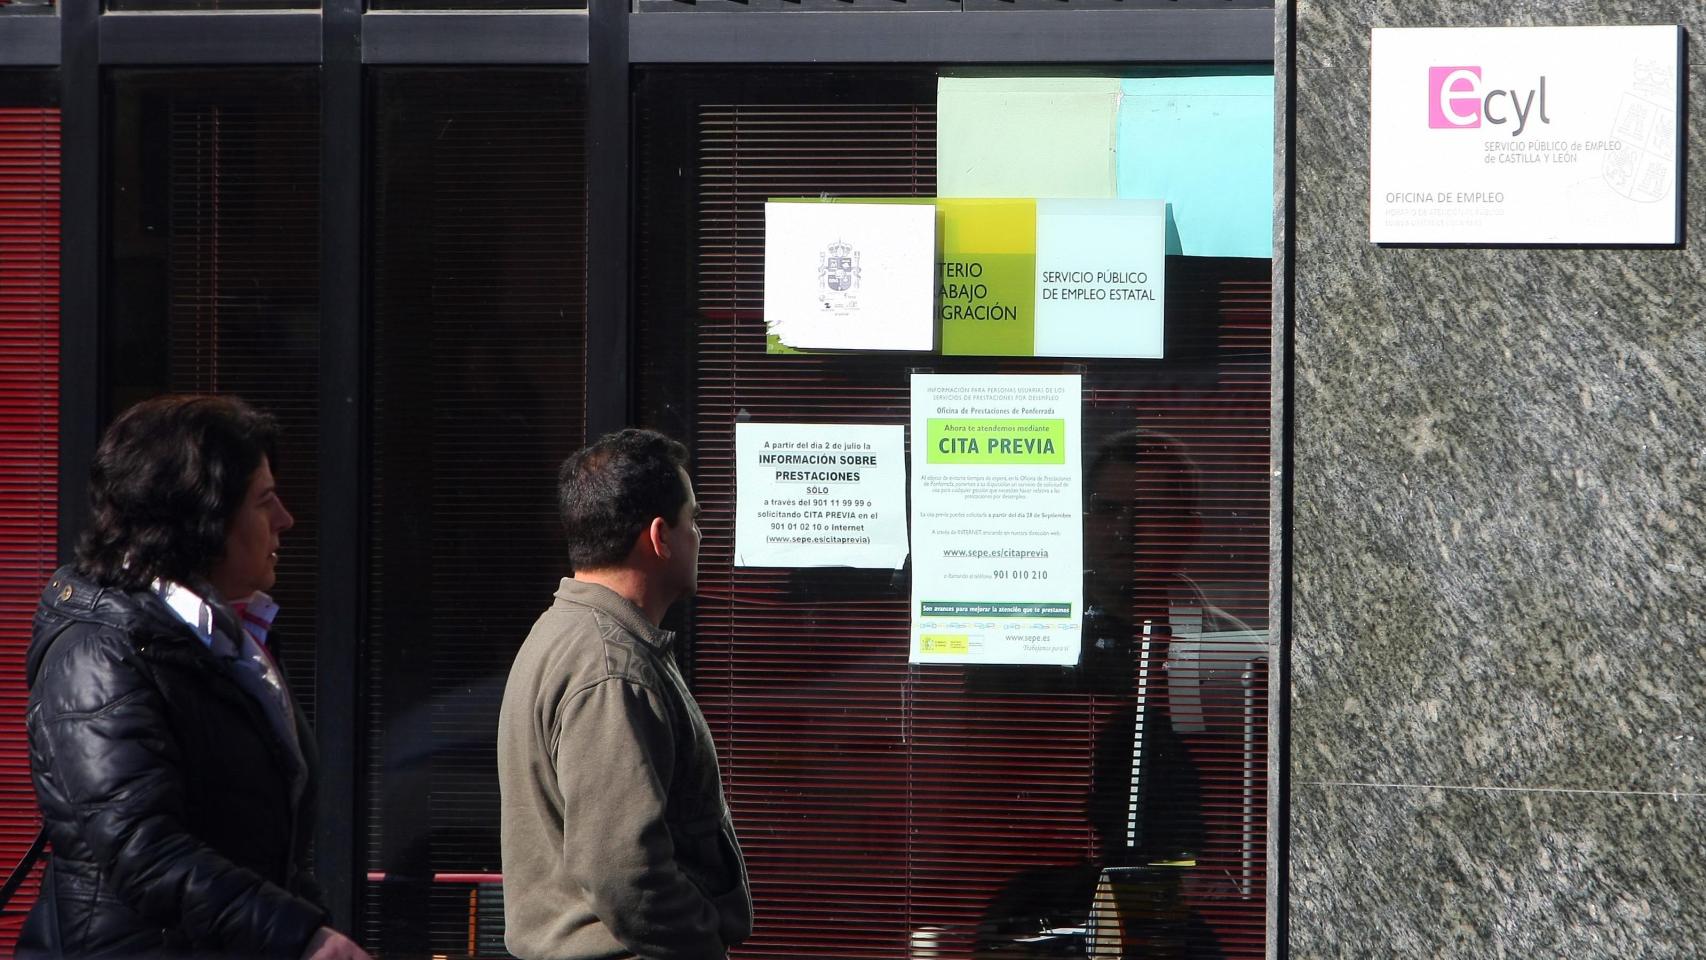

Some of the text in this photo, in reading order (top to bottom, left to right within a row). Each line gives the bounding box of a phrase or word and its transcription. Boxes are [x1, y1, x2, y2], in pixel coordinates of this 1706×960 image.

[1440, 68, 1550, 137] ecyl
[1484, 139, 1622, 152] SERVICIO PÚBLICO de EMPLEO
[1484, 151, 1577, 164] de CASTILLA Y LEÓN
[1386, 192, 1504, 203] OFICINA DE EMPLEO
[1042, 268, 1148, 284] SERVICIO PÚBLICO
[936, 284, 987, 303] ABAJO
[1042, 288, 1156, 300] DE EMPLEO ESTATAL
[934, 302, 1017, 320] IGRACIÓN
[936, 407, 1055, 415] Oficina de Prestaciones de Ponferrada
[772, 441, 794, 450] partir
[844, 442, 861, 451] julio
[939, 437, 1055, 454] CITA PREVIA
[759, 452, 877, 465] INFORMACIÓN SOBRE
[775, 471, 860, 482] PRESTACIONES
[812, 499, 827, 507] 901
[830, 499, 839, 507] 11
[842, 499, 852, 507] 99
[854, 499, 864, 507] 99
[770, 523, 785, 531] 901
[787, 523, 796, 531] 01
[799, 523, 810, 531] 02
[812, 523, 822, 531] 10
[943, 548, 1048, 559] www.sepe.es/citaprevia
[993, 570, 1008, 580] 901
[1012, 570, 1029, 580] 010
[1032, 570, 1048, 580] 210
[969, 606, 991, 614] mejorar
[1005, 634, 1050, 642] www.sepe.es
